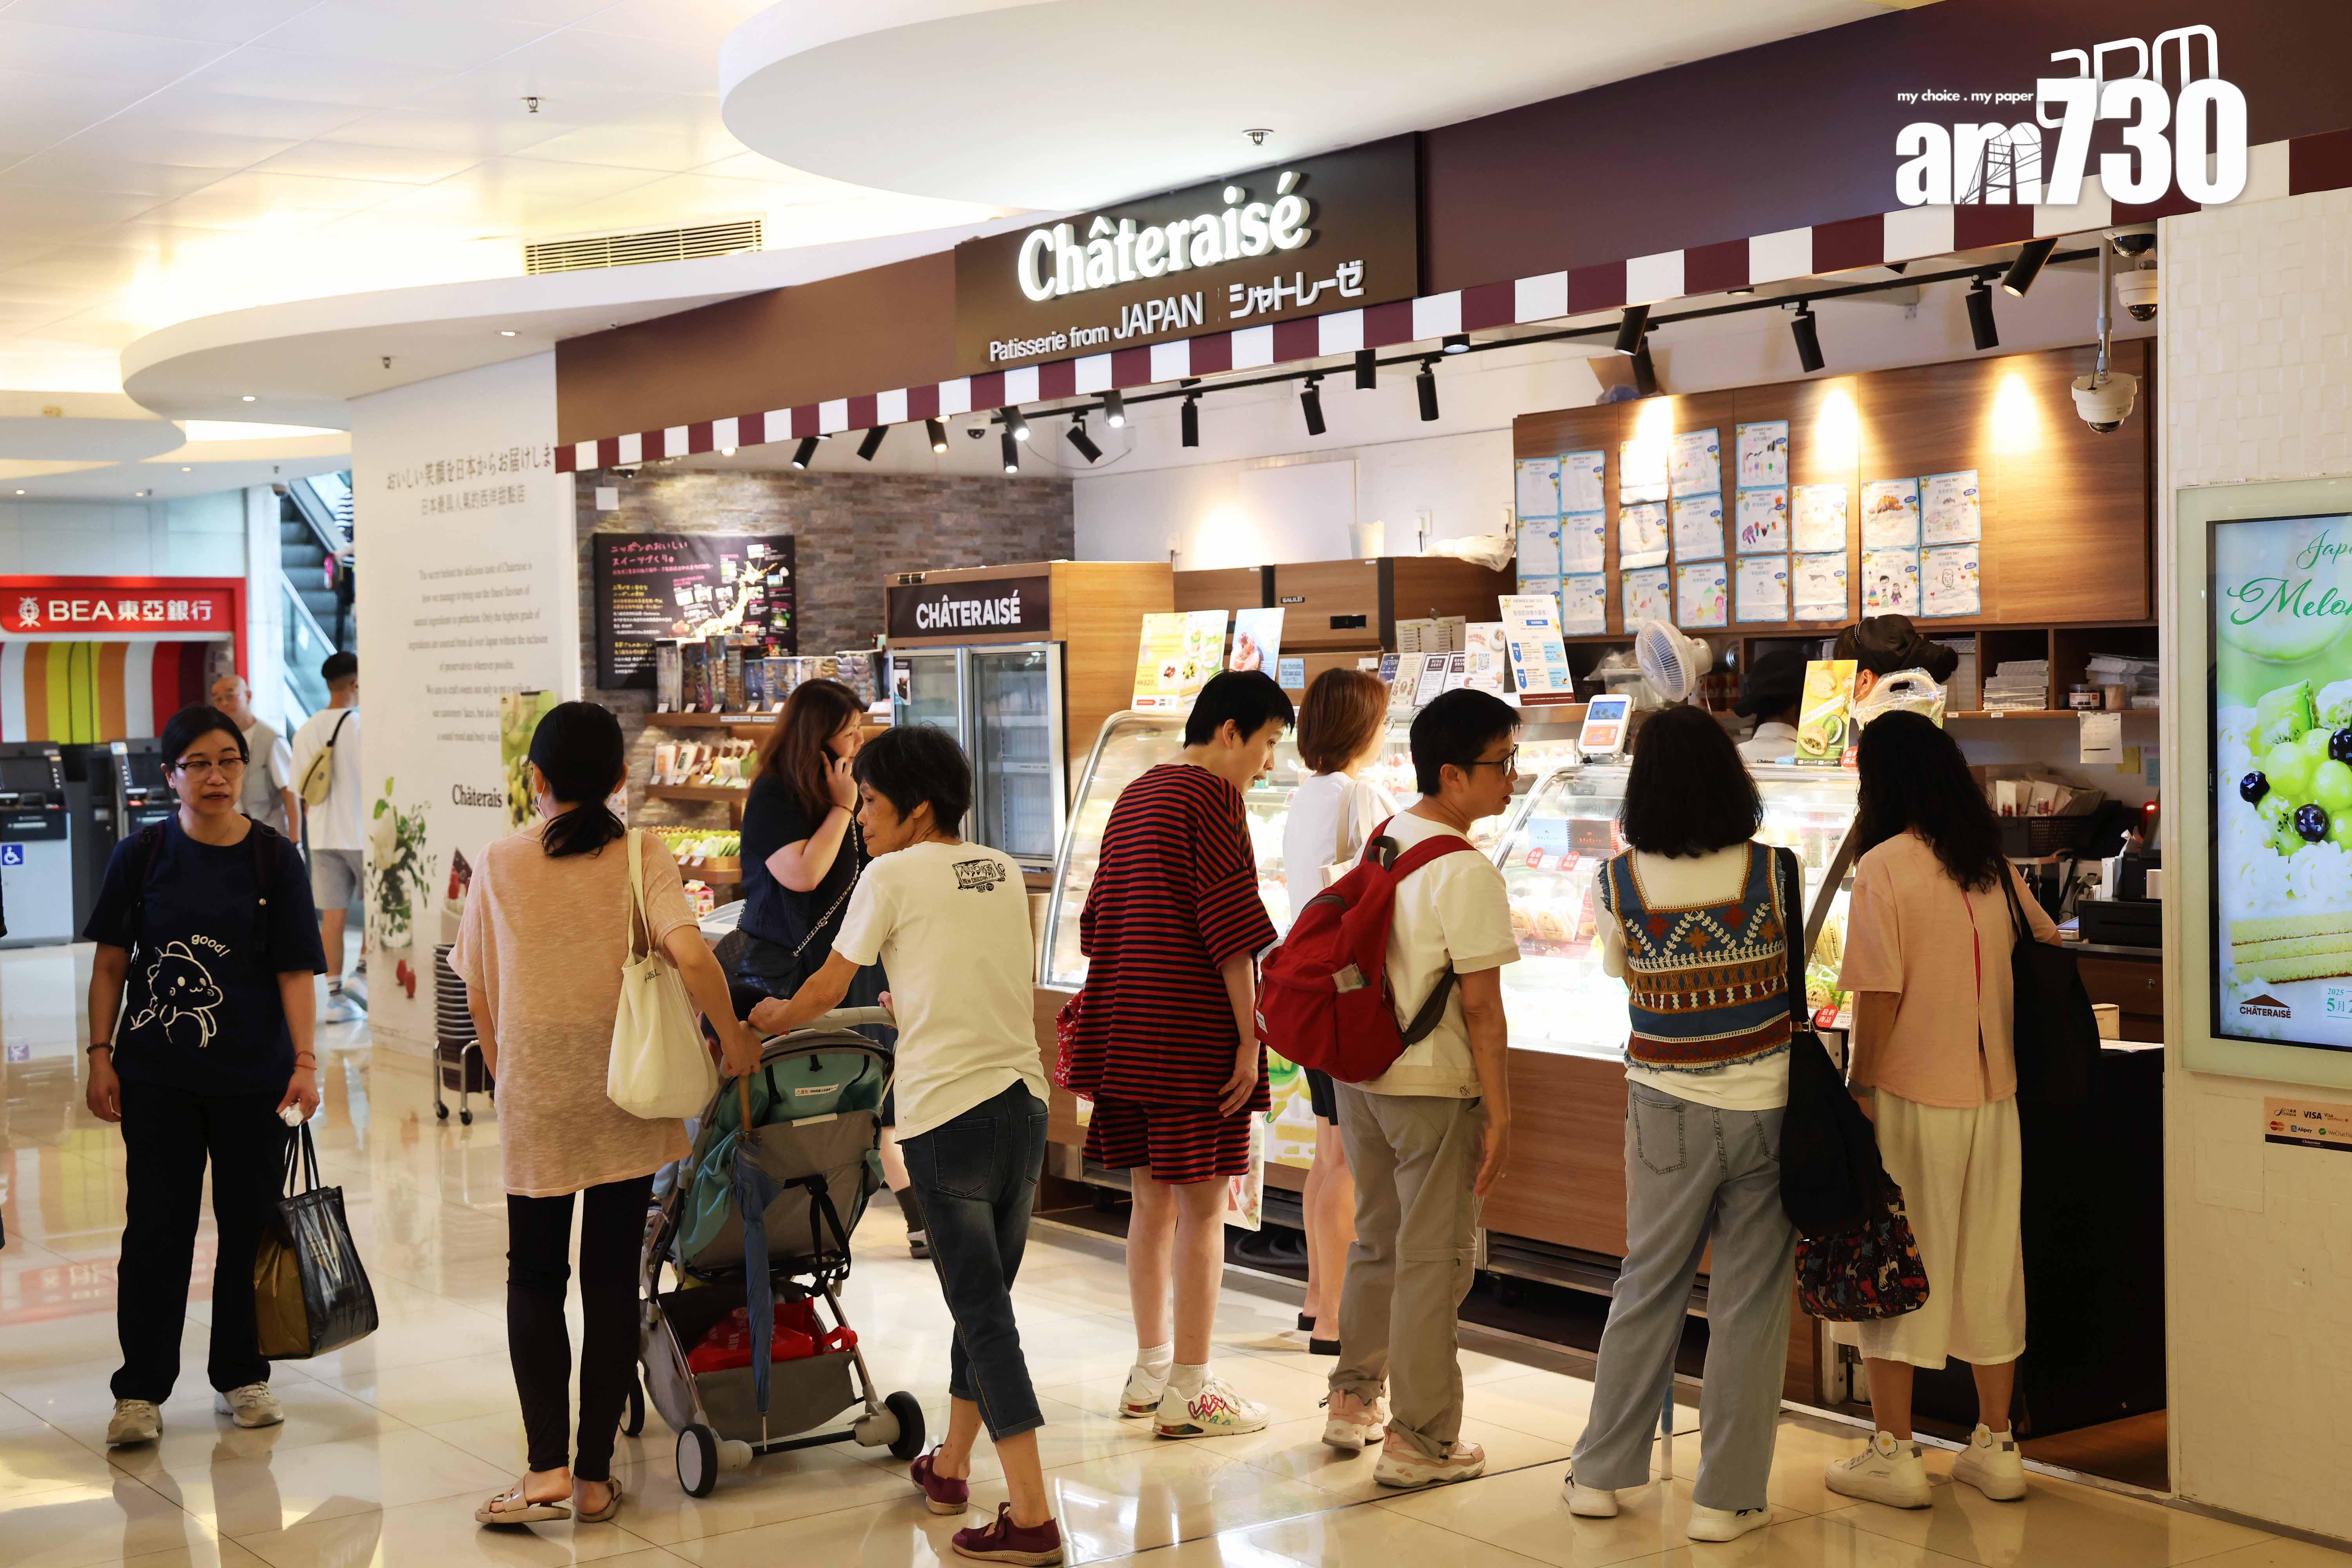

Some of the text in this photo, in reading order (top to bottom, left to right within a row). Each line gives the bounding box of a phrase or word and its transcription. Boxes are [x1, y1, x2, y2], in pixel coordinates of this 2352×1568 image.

[1018, 171, 1311, 302] Châteraisé
[1228, 259, 1366, 320] シャトレーゼ
[989, 291, 1205, 362] Patisserie from JAPAN
[48, 599, 212, 622] BEA 東亞銀行
[916, 590, 1022, 628] CHÂTERAISÉ
[191, 934, 231, 958] good!
[2239, 1005, 2292, 1019] CHÂTERAISÉ
[2303, 1110, 2322, 1120] VISA
